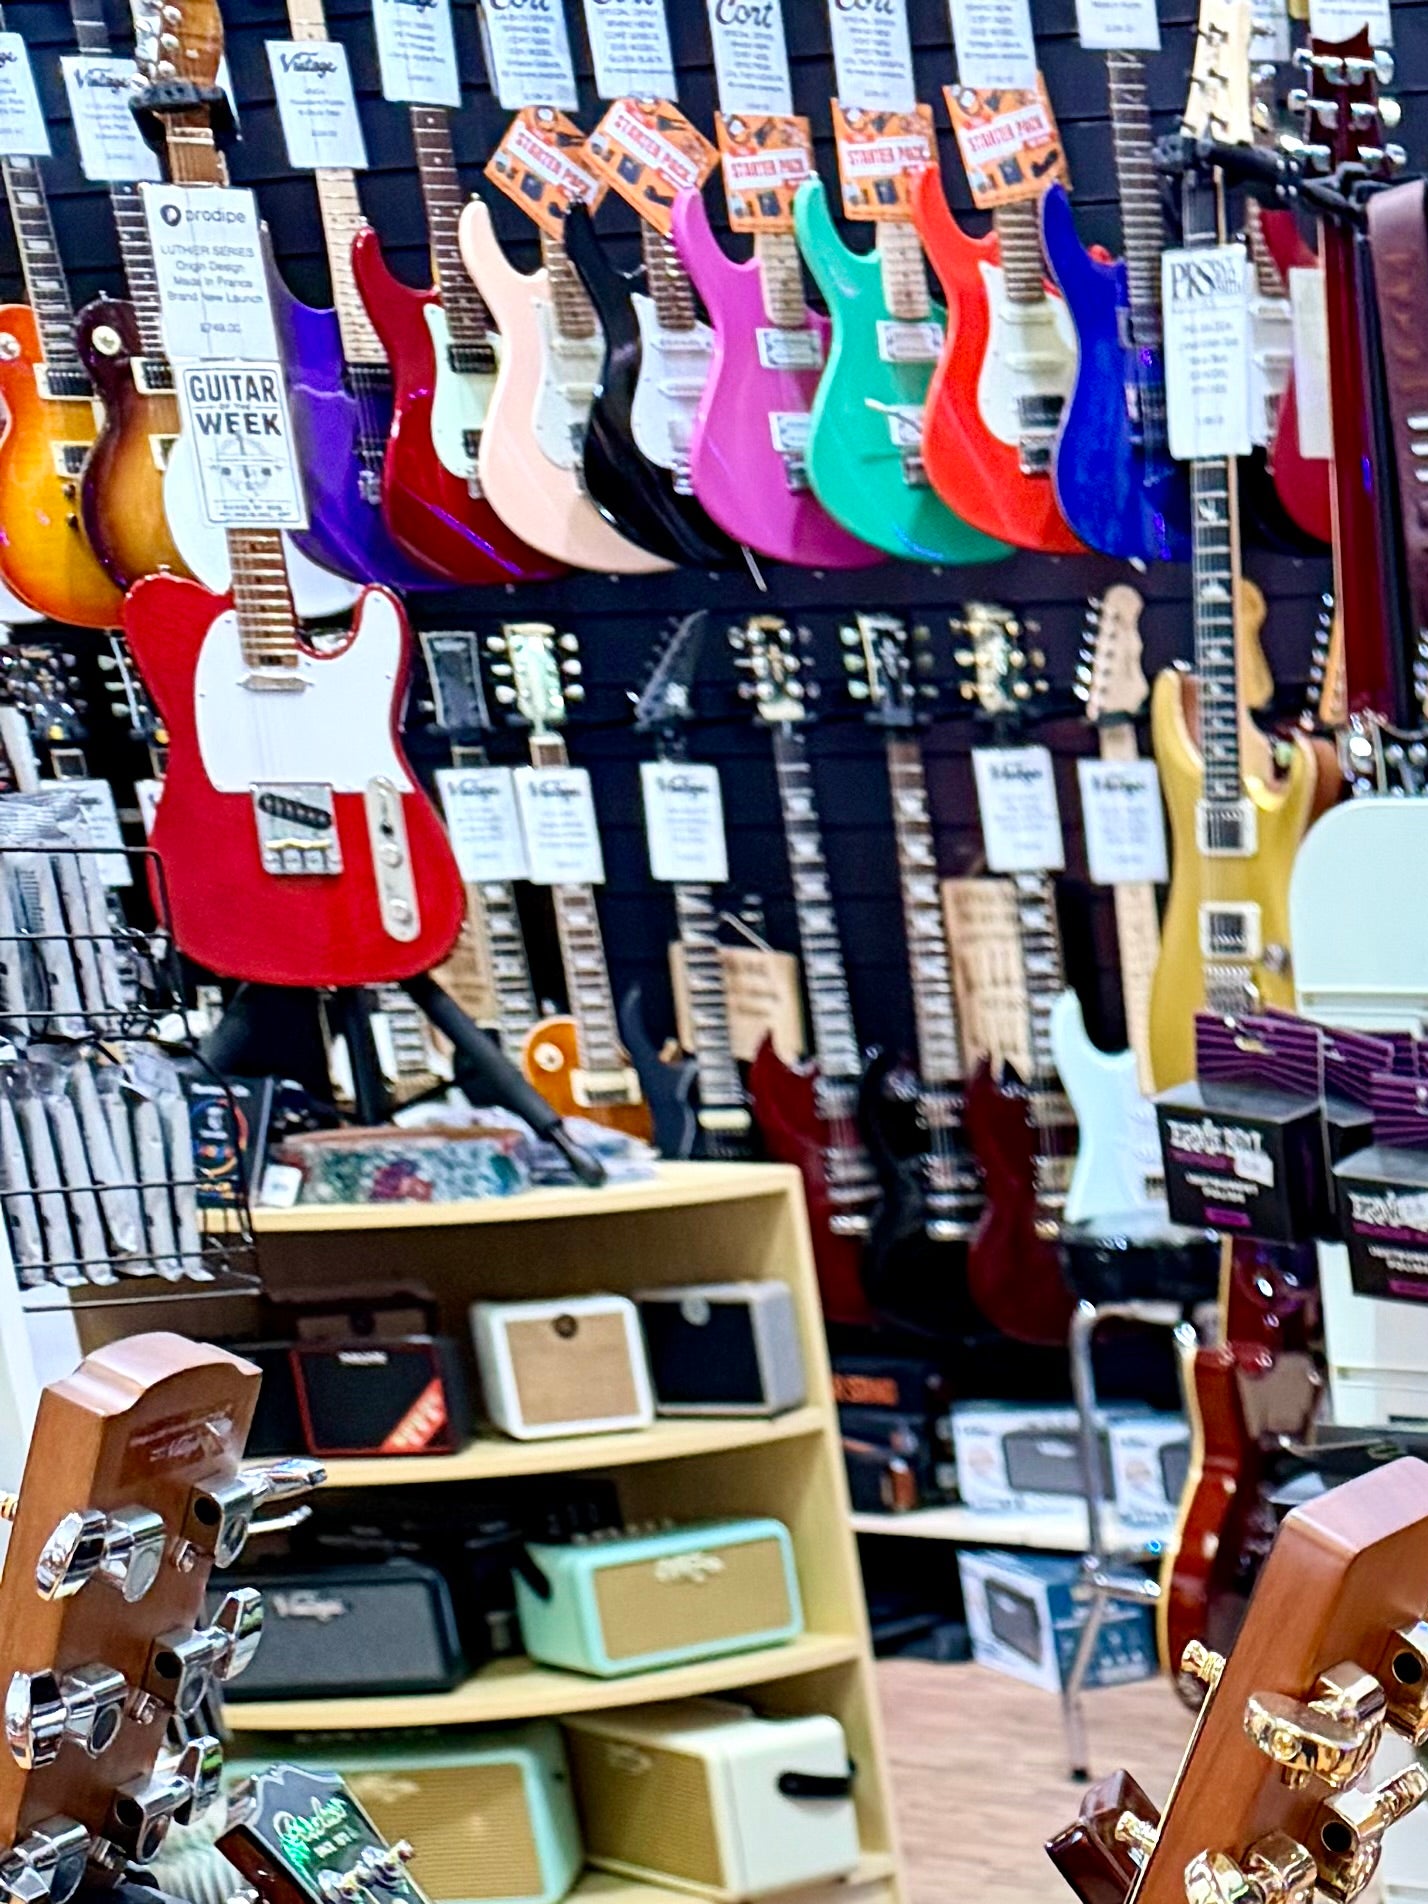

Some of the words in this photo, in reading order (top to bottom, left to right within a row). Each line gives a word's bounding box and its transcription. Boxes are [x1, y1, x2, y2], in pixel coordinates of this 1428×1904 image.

[715, 0, 772, 29] Cort
[280, 51, 339, 78] Vintage
[185, 207, 247, 224] prodipe
[216, 276, 253, 288] France
[189, 373, 278, 403] GUITAR
[195, 412, 282, 437] WEEK
